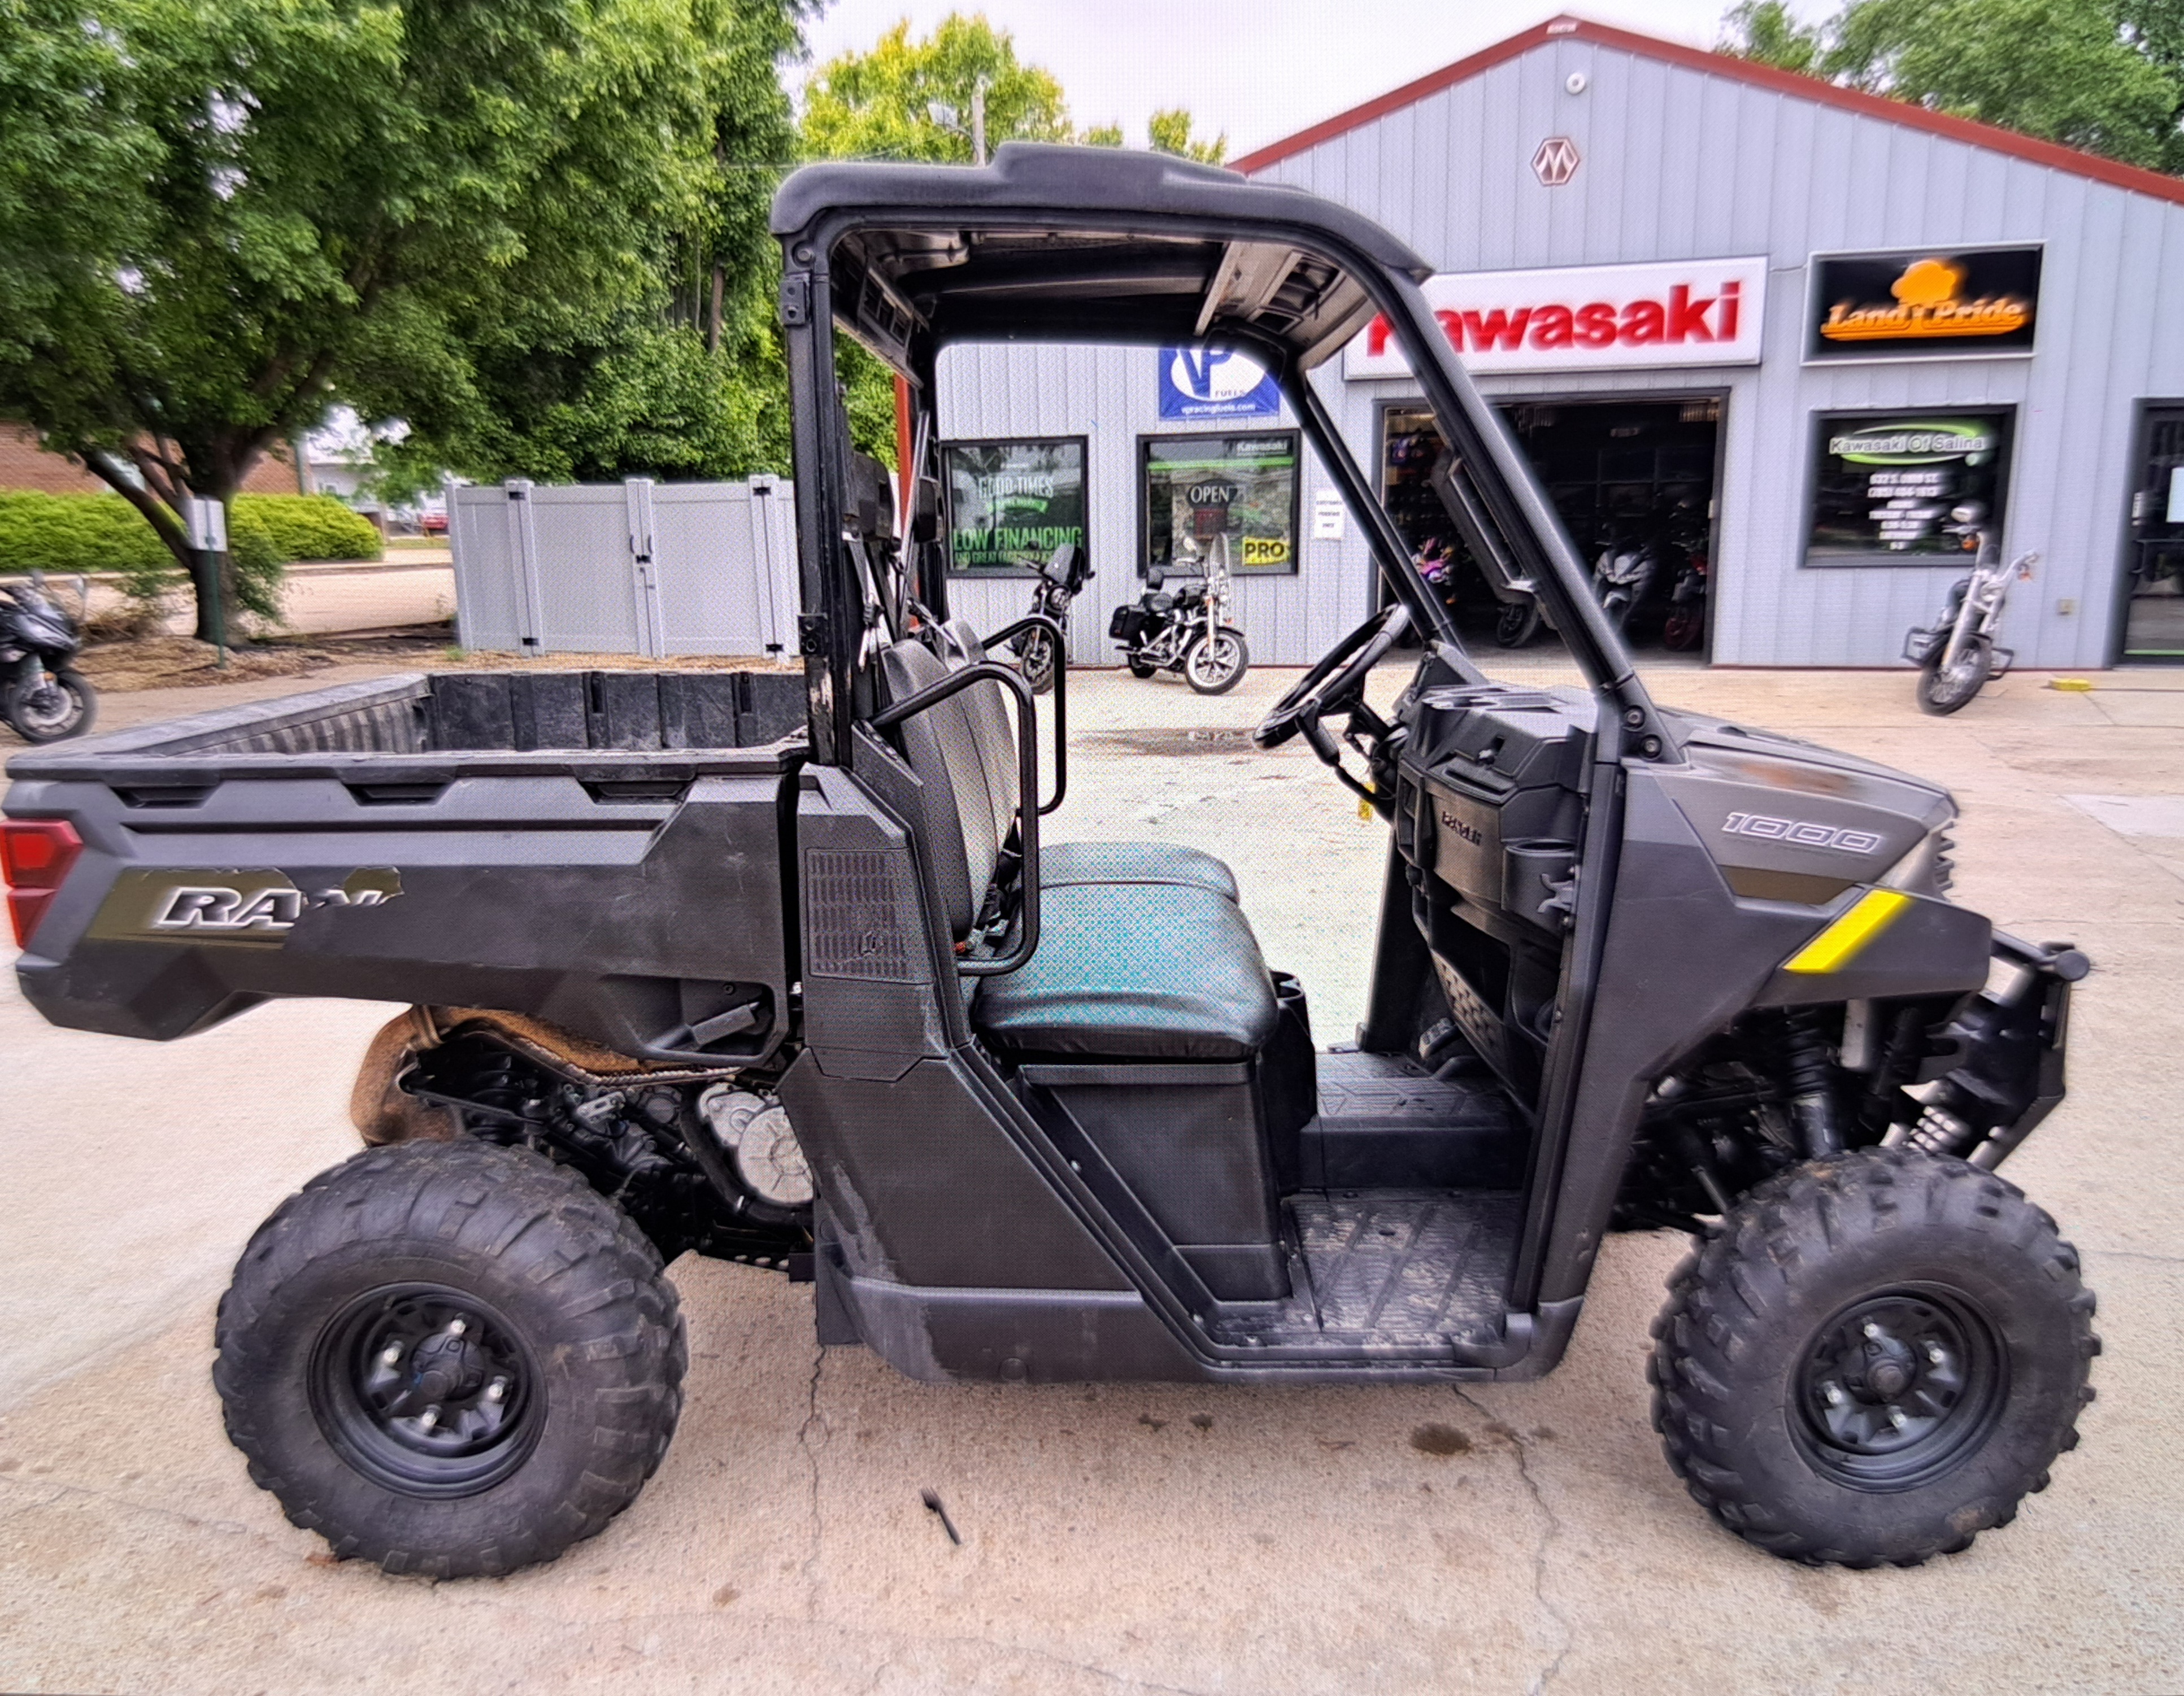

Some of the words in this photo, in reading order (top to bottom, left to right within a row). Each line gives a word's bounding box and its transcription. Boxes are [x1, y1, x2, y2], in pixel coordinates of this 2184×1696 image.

[1829, 432, 1905, 454] Kawasaki
[1932, 433, 1985, 451] Salina
[978, 477, 1013, 499] GOOD
[1017, 476, 1055, 498] TIMES
[1190, 485, 1229, 503] OPEN
[953, 527, 989, 551] LOW
[994, 526, 1082, 551] FINANCING
[1245, 542, 1285, 558] PRO
[1721, 812, 1881, 854] 1000
